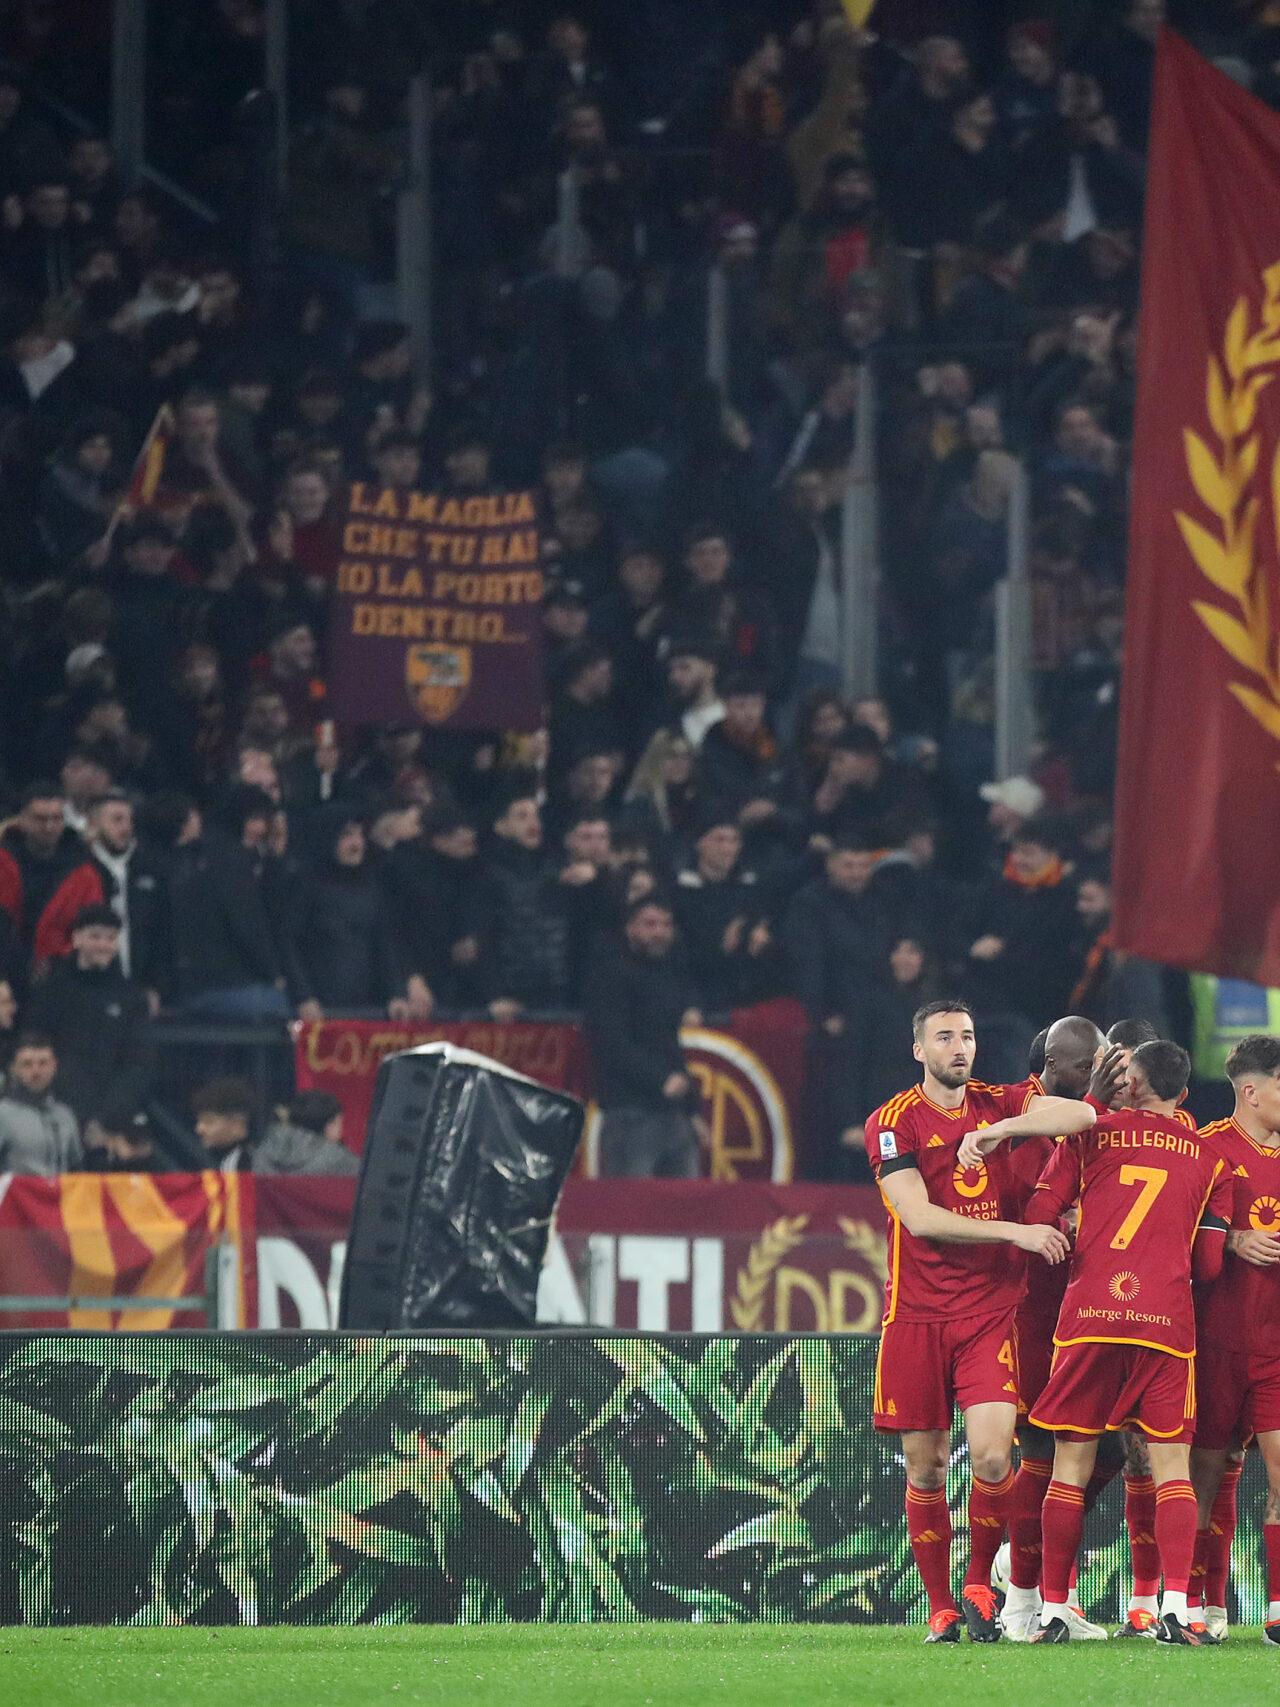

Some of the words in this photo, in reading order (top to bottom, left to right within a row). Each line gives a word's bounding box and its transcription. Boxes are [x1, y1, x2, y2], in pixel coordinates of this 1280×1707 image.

[350, 482, 398, 519] LA
[406, 492, 537, 527] MAGLIA
[344, 523, 419, 558] CHE
[425, 533, 477, 565] TU
[480, 530, 539, 565] HAI
[378, 564, 424, 597] LA
[432, 571, 545, 604] PORTO
[1097, 1130, 1200, 1160] PELLEGRINI
[1109, 1164, 1168, 1250] 7
[1076, 1306, 1122, 1323] Auberge
[1125, 1309, 1172, 1327] Resorts
[997, 1340, 1014, 1373] 4
